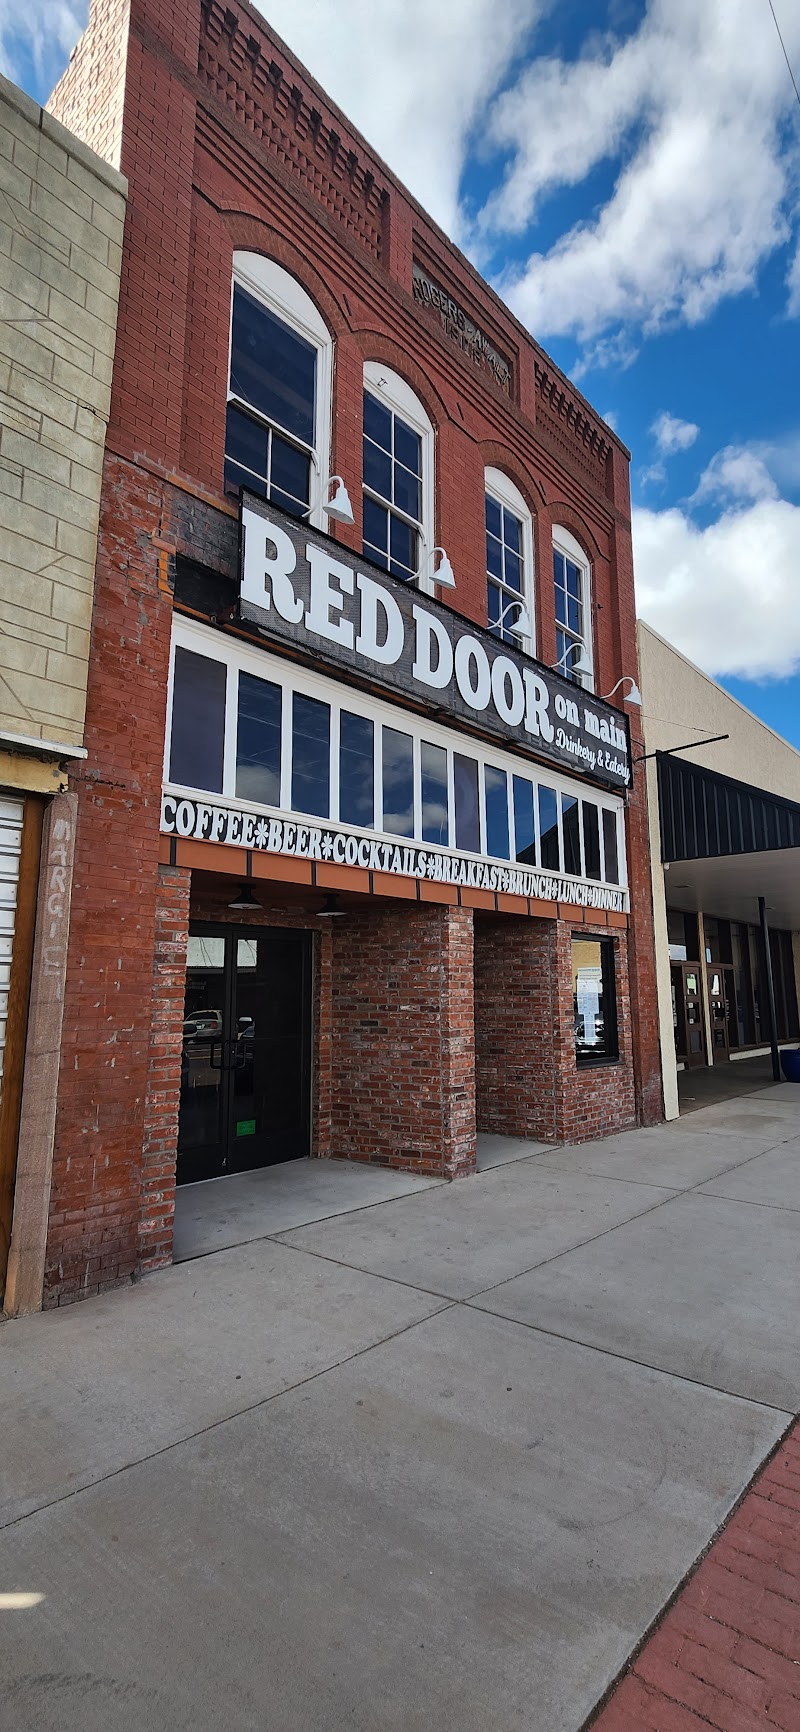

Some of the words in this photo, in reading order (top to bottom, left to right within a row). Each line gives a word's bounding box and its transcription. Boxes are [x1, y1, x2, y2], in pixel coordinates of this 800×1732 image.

[240, 507, 404, 665] RED
[412, 604, 554, 743] DOOR
[555, 694, 580, 727] on
[584, 707, 628, 753] main
[555, 728, 597, 770] Drinkery
[597, 750, 605, 768] &
[604, 750, 631, 786] Eatery
[160, 796, 257, 848] COFFEE
[268, 819, 323, 859] BEER
[333, 834, 427, 879] COCKTAILS
[434, 854, 504, 892] BREAKFAST
[508, 869, 552, 899] BRUNCH
[557, 880, 588, 904] LUNCH
[592, 887, 623, 912] DINNER
